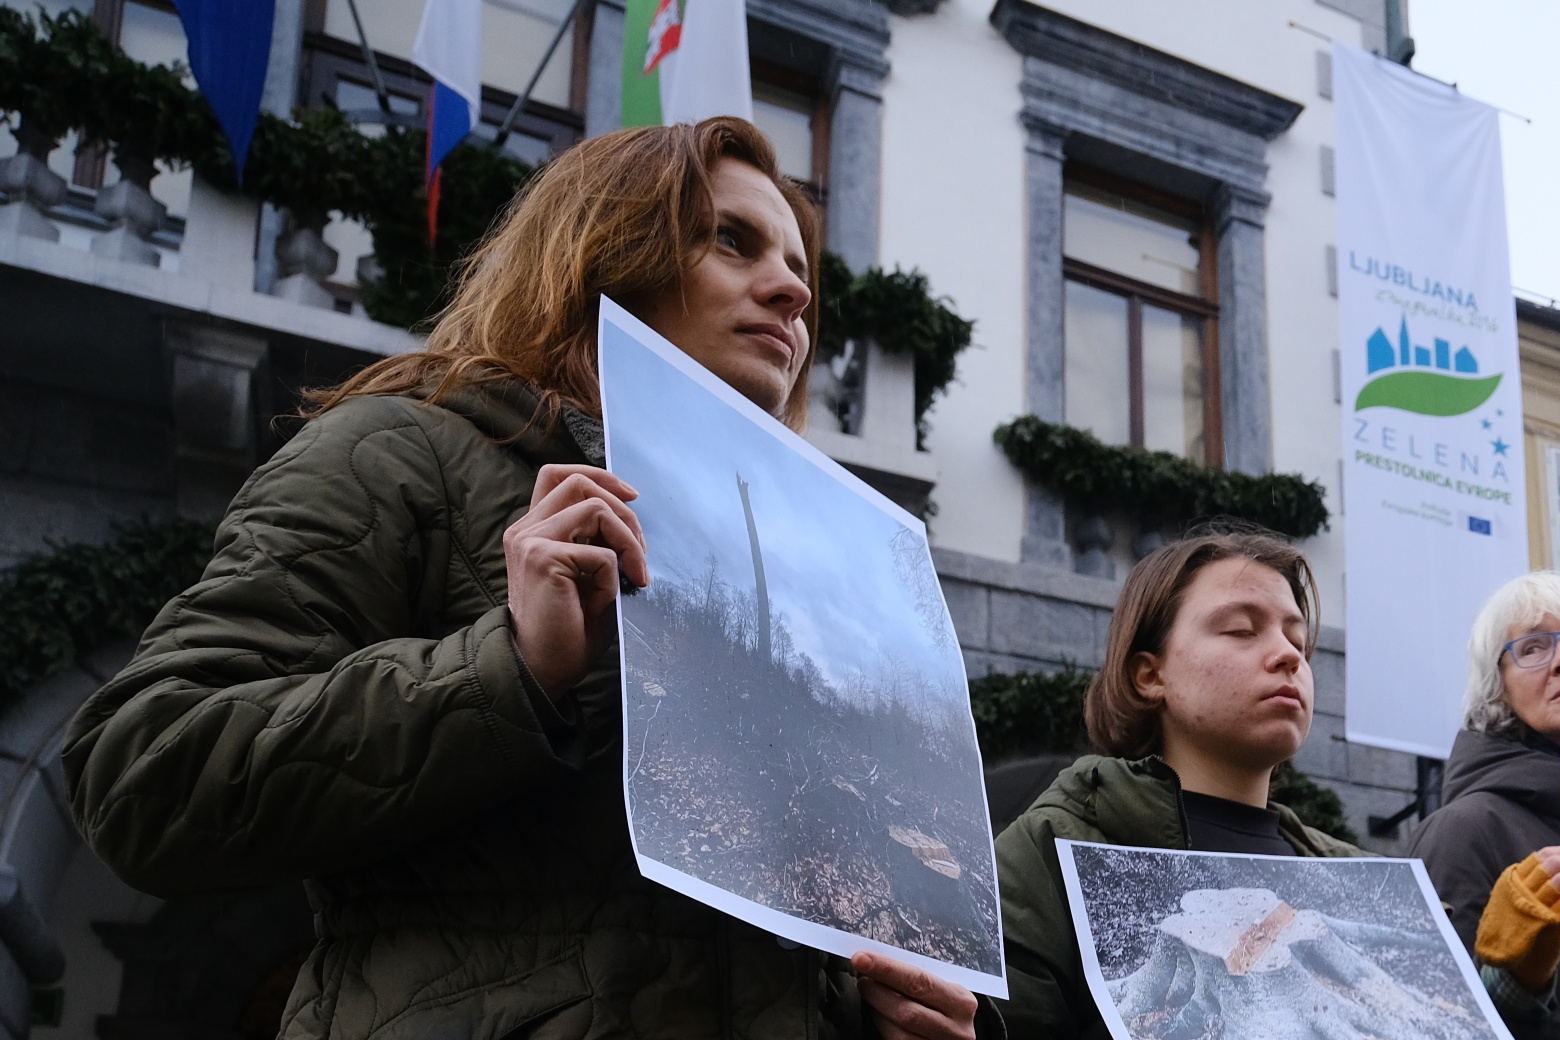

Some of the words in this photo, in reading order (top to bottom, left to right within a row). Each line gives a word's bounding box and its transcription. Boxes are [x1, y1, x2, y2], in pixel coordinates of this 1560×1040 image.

[1349, 250, 1479, 311] LJUBLJANA
[1354, 417, 1510, 482] ZELENA
[1355, 449, 1454, 490] PRESTOLNICA
[1455, 480, 1512, 505] EVROPE
